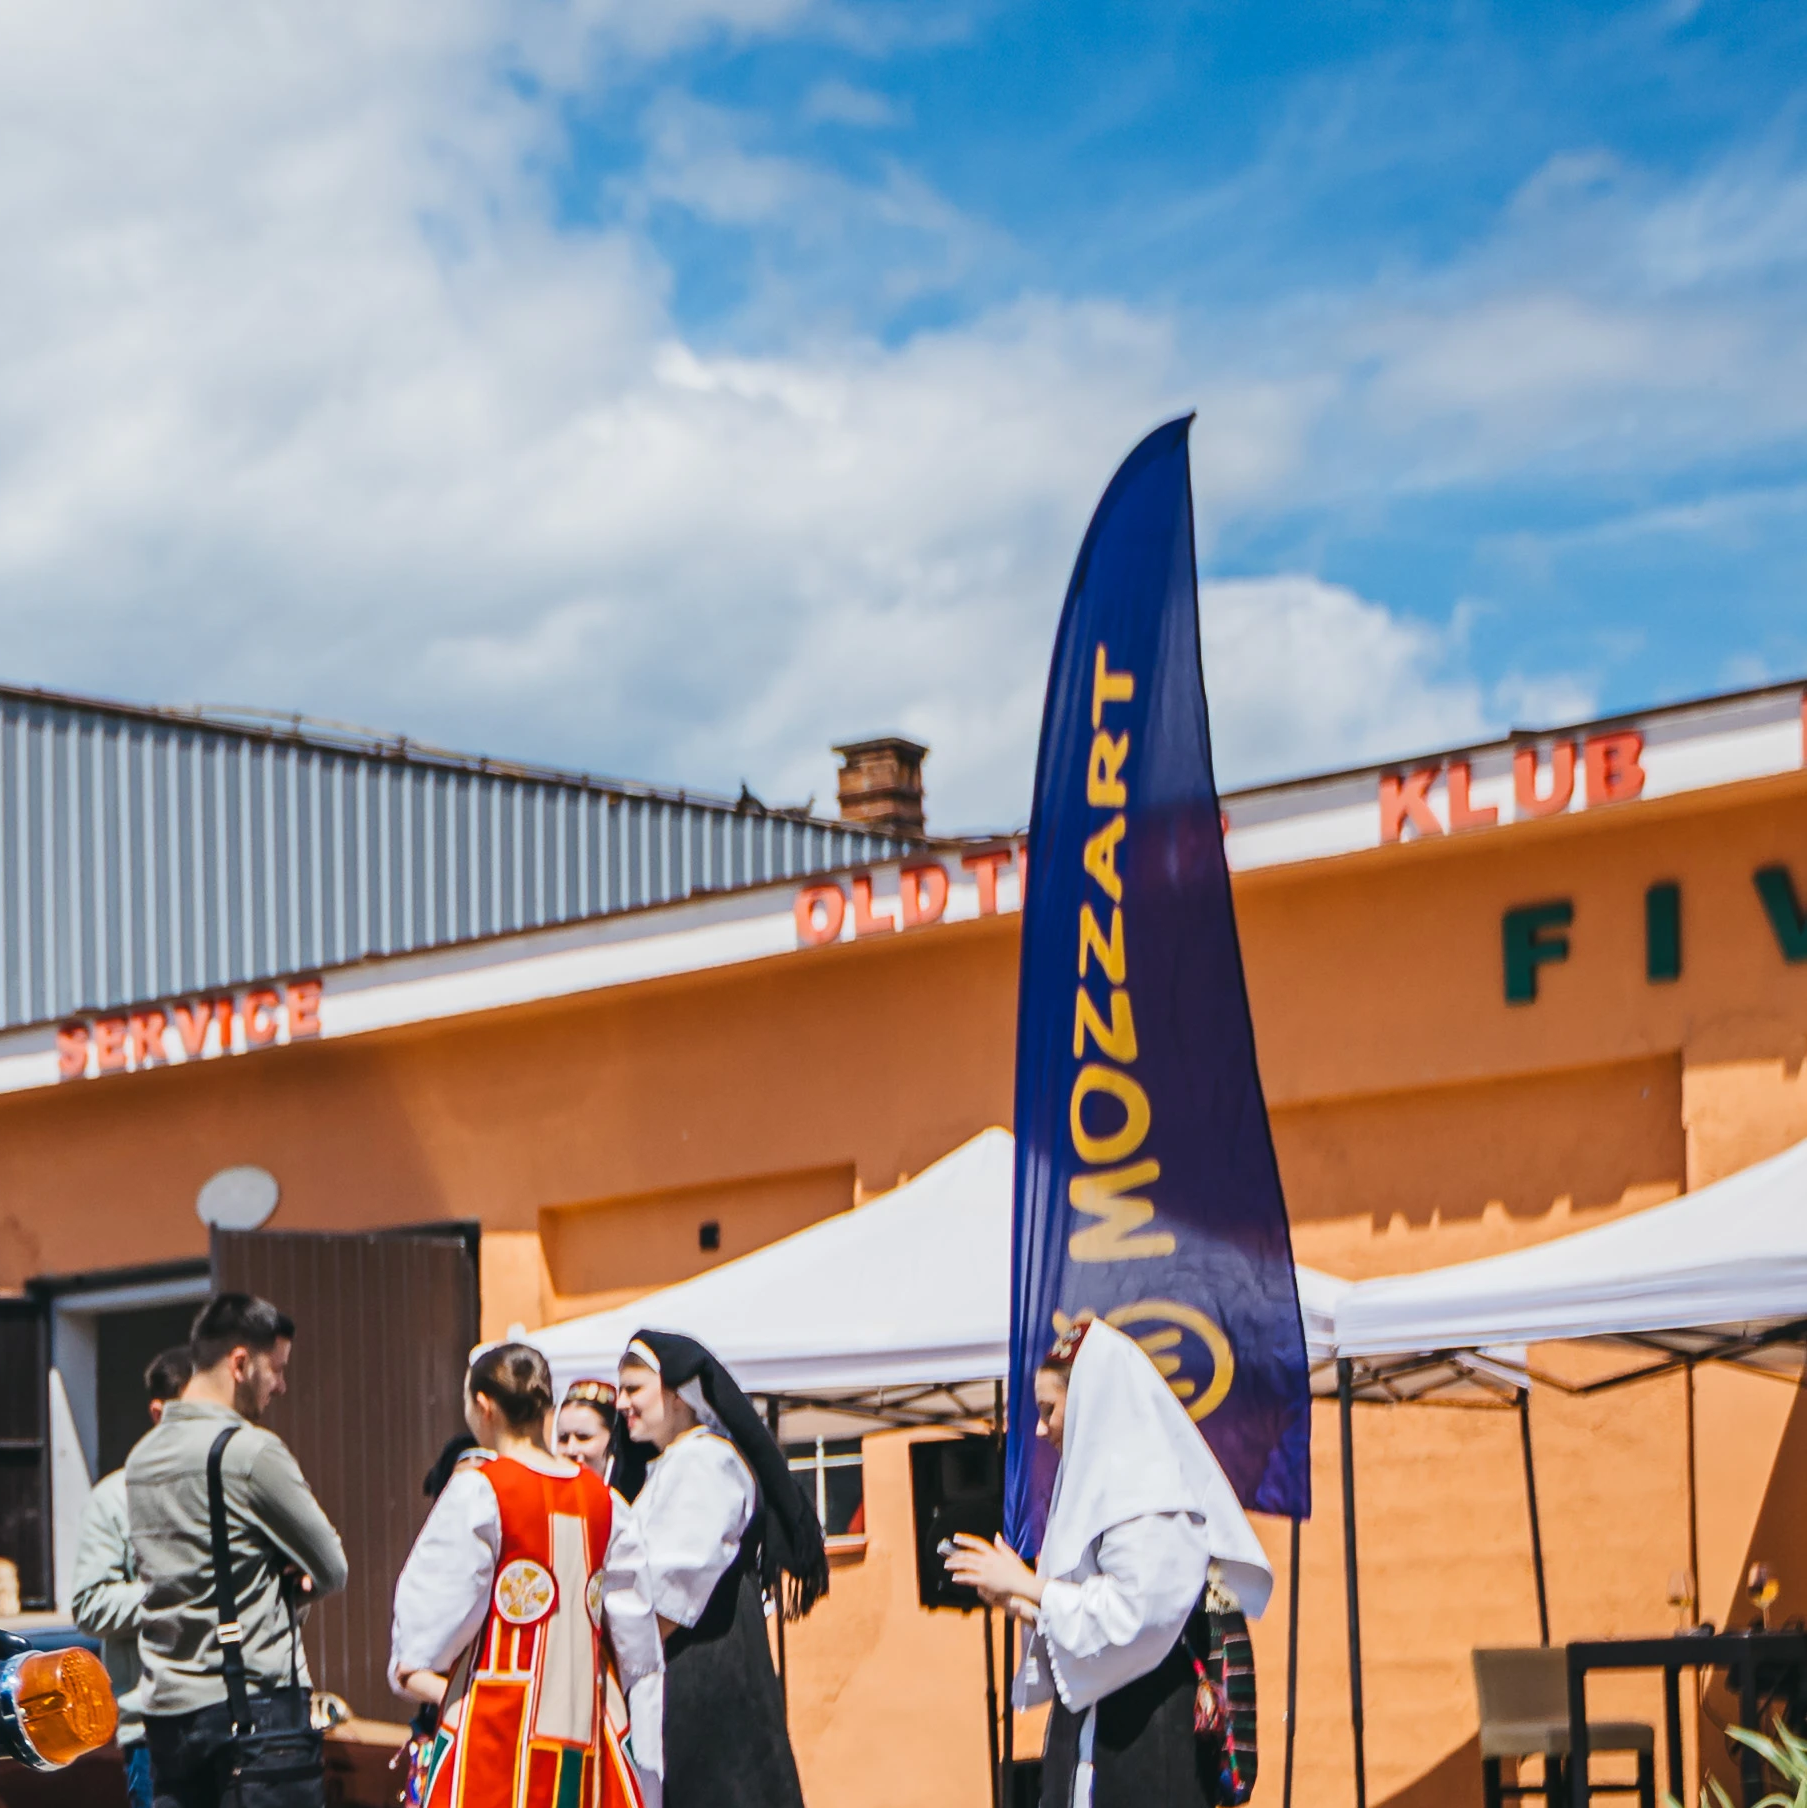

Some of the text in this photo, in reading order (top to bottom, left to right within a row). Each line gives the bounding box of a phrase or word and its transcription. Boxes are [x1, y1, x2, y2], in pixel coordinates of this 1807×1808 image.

[1379, 729, 1646, 843] KLUB
[1068, 642, 1177, 1263] MOZZART
[56, 978, 323, 1077] SERVICE
